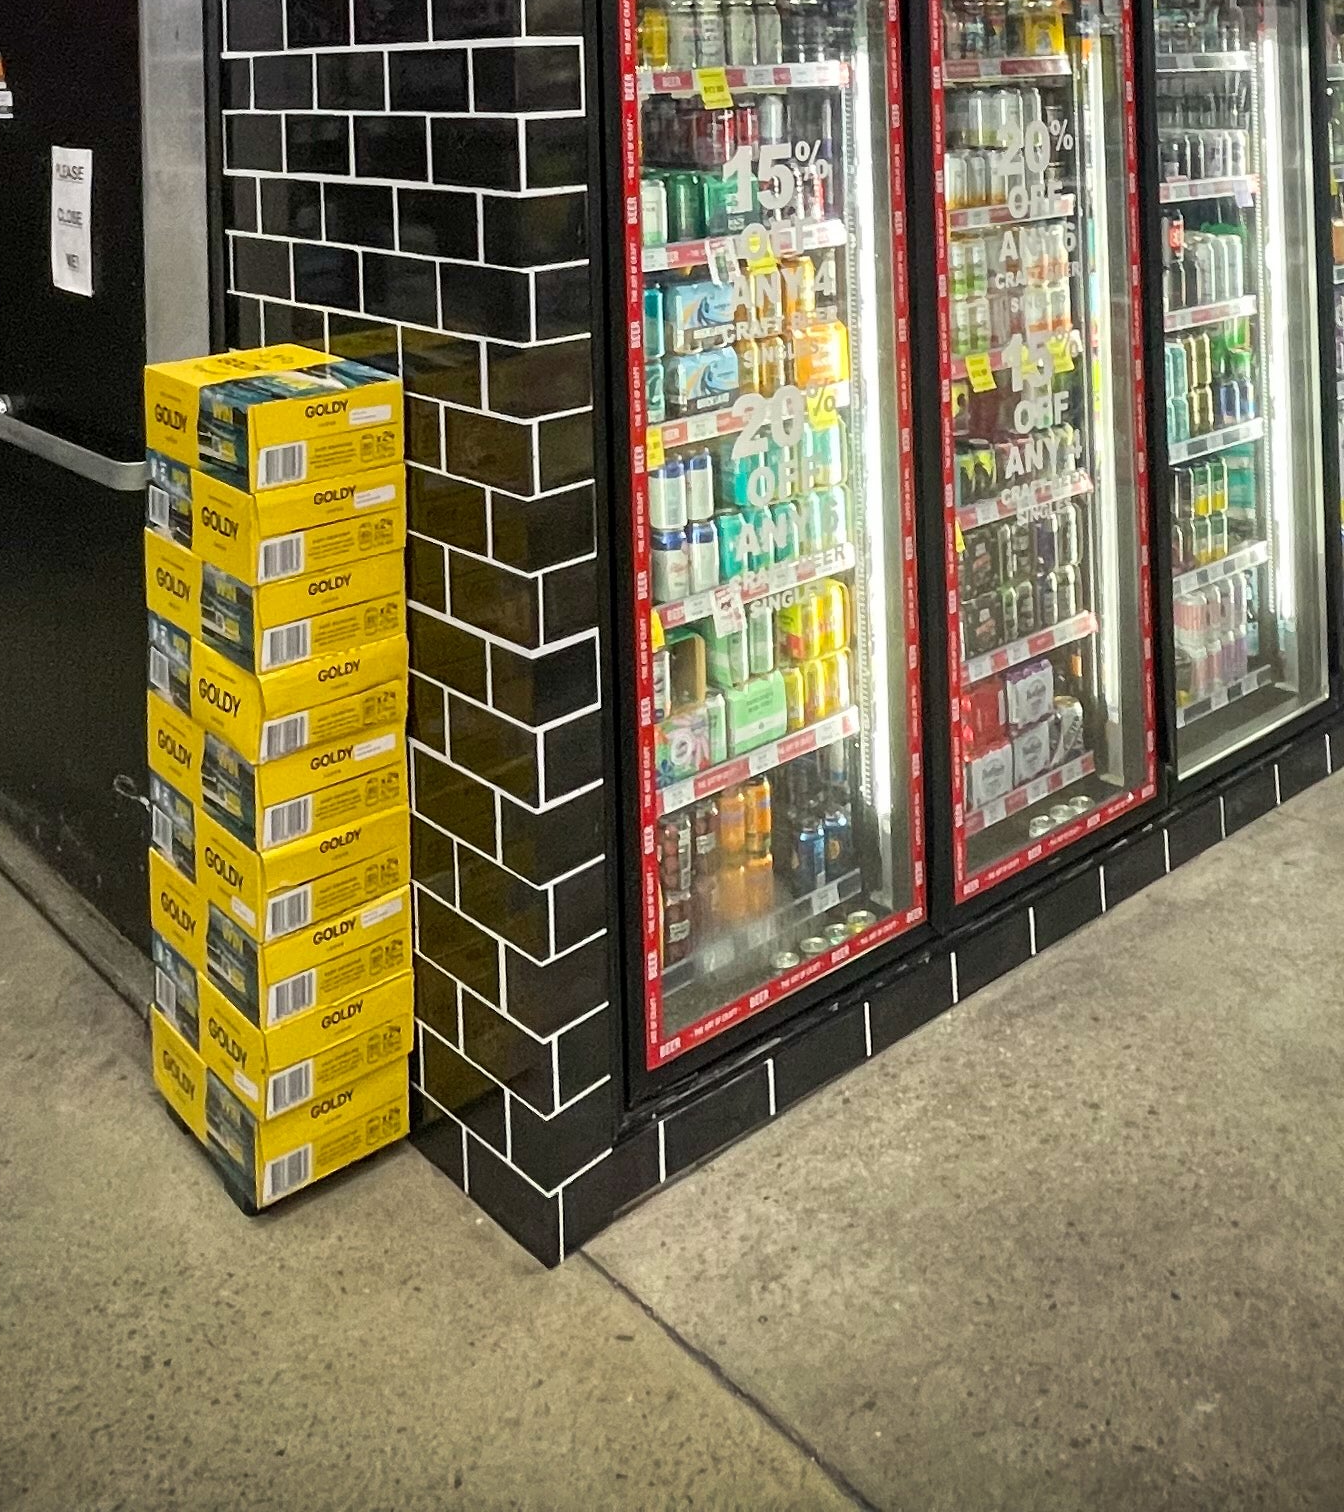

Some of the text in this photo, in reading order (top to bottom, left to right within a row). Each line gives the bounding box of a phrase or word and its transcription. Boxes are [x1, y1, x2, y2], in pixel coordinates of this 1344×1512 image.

[996, 119, 1073, 176] 20%
[723, 139, 829, 214] 15%
[733, 267, 806, 313] ANY
[154, 402, 188, 433] GOLDY
[305, 399, 349, 419] GOLDY
[731, 384, 837, 460] 20%
[314, 485, 356, 505] GOLDY
[201, 506, 239, 541] GOLDY
[156, 566, 191, 602] GOLDY
[308, 573, 352, 596] GOLDY
[318, 659, 361, 683] GOLDY
[199, 678, 241, 718] GOLDY
[157, 729, 192, 769] GOLDY
[310, 745, 355, 771] GOLDY
[319, 827, 362, 855] GOLDY
[204, 846, 245, 893] GOLDY
[160, 890, 197, 937] GOLDY
[313, 918, 356, 946] GOLDY
[321, 999, 364, 1029] GOLDY
[208, 1015, 248, 1069] GOLDY
[163, 1049, 196, 1102] GOLDY
[310, 1089, 354, 1119] GOLDY
